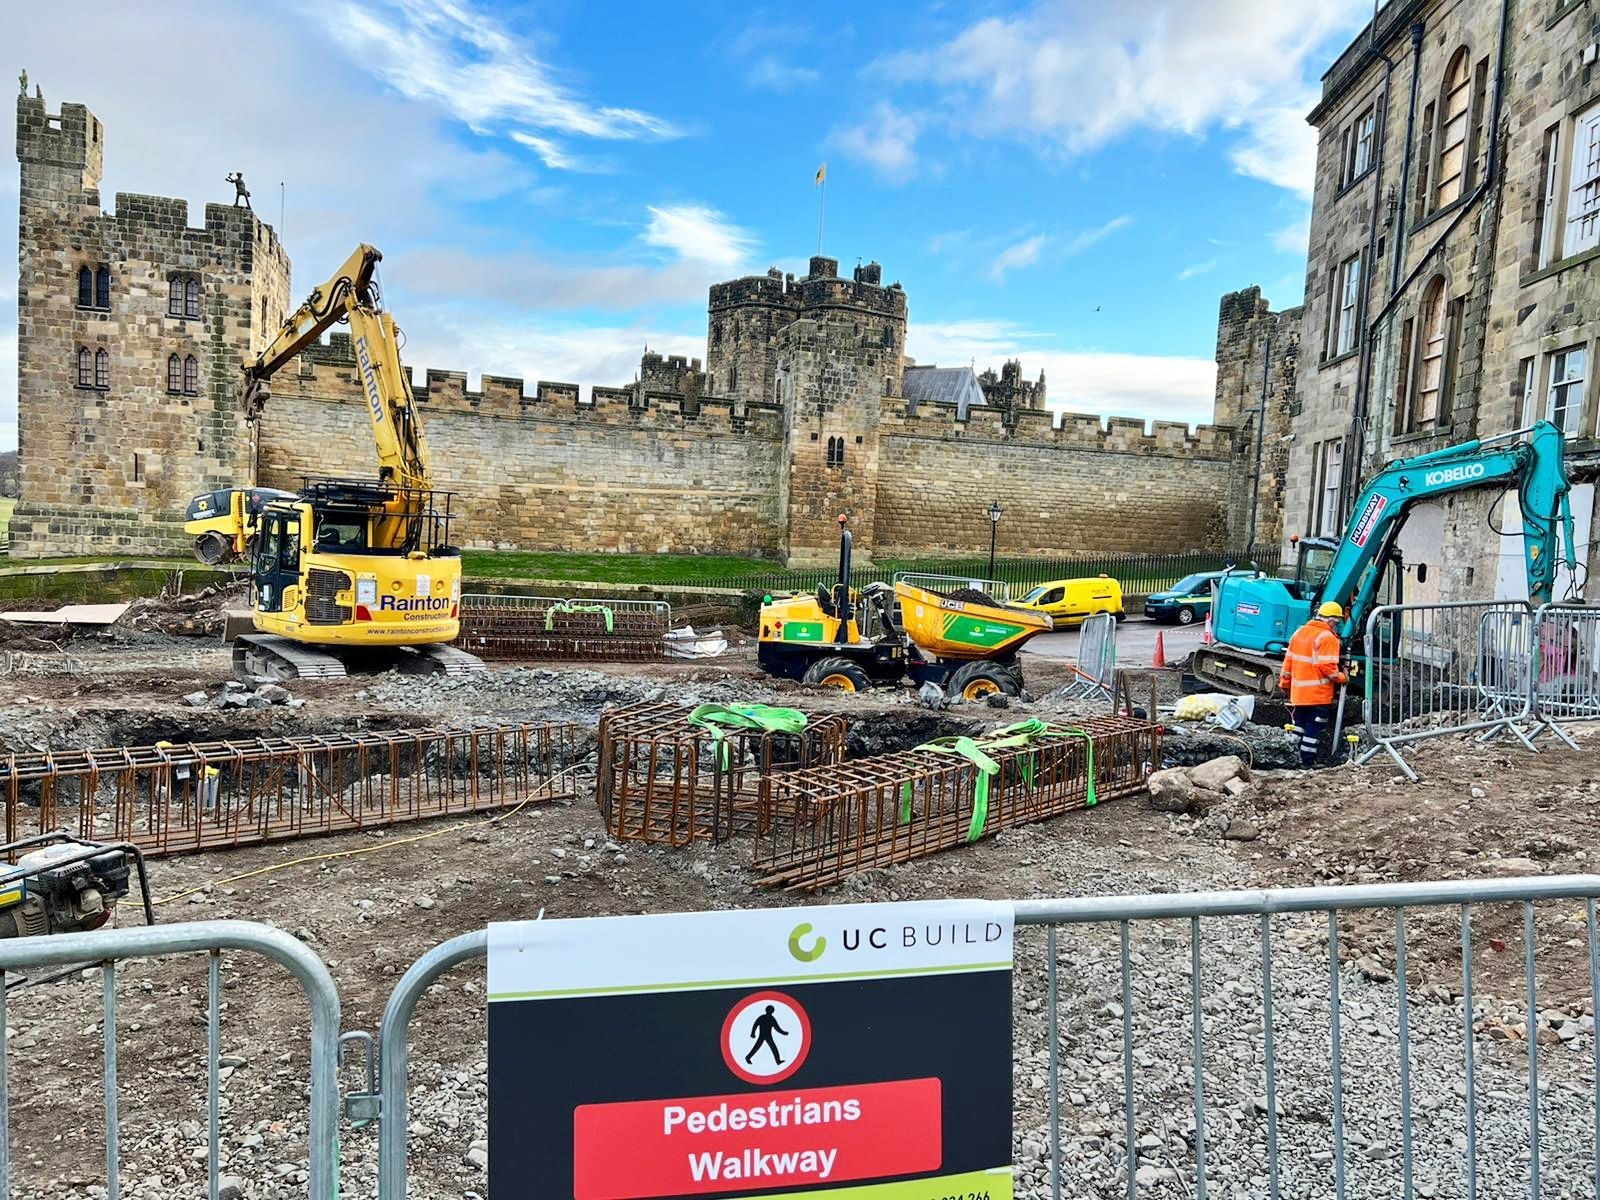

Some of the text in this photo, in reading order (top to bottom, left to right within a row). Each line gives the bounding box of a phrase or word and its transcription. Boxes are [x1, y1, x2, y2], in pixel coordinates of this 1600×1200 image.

[356, 336, 384, 423] Rainton
[1425, 463, 1485, 487] KOBELCO
[1351, 494, 1379, 543] HUBBWAY
[380, 595, 449, 611] Rainton
[403, 612, 449, 621] Construction
[940, 601, 964, 610] JCB
[843, 922, 1003, 951] UC BUILD
[663, 1097, 861, 1136] Pedestrians
[688, 1147, 838, 1183] Walkway
